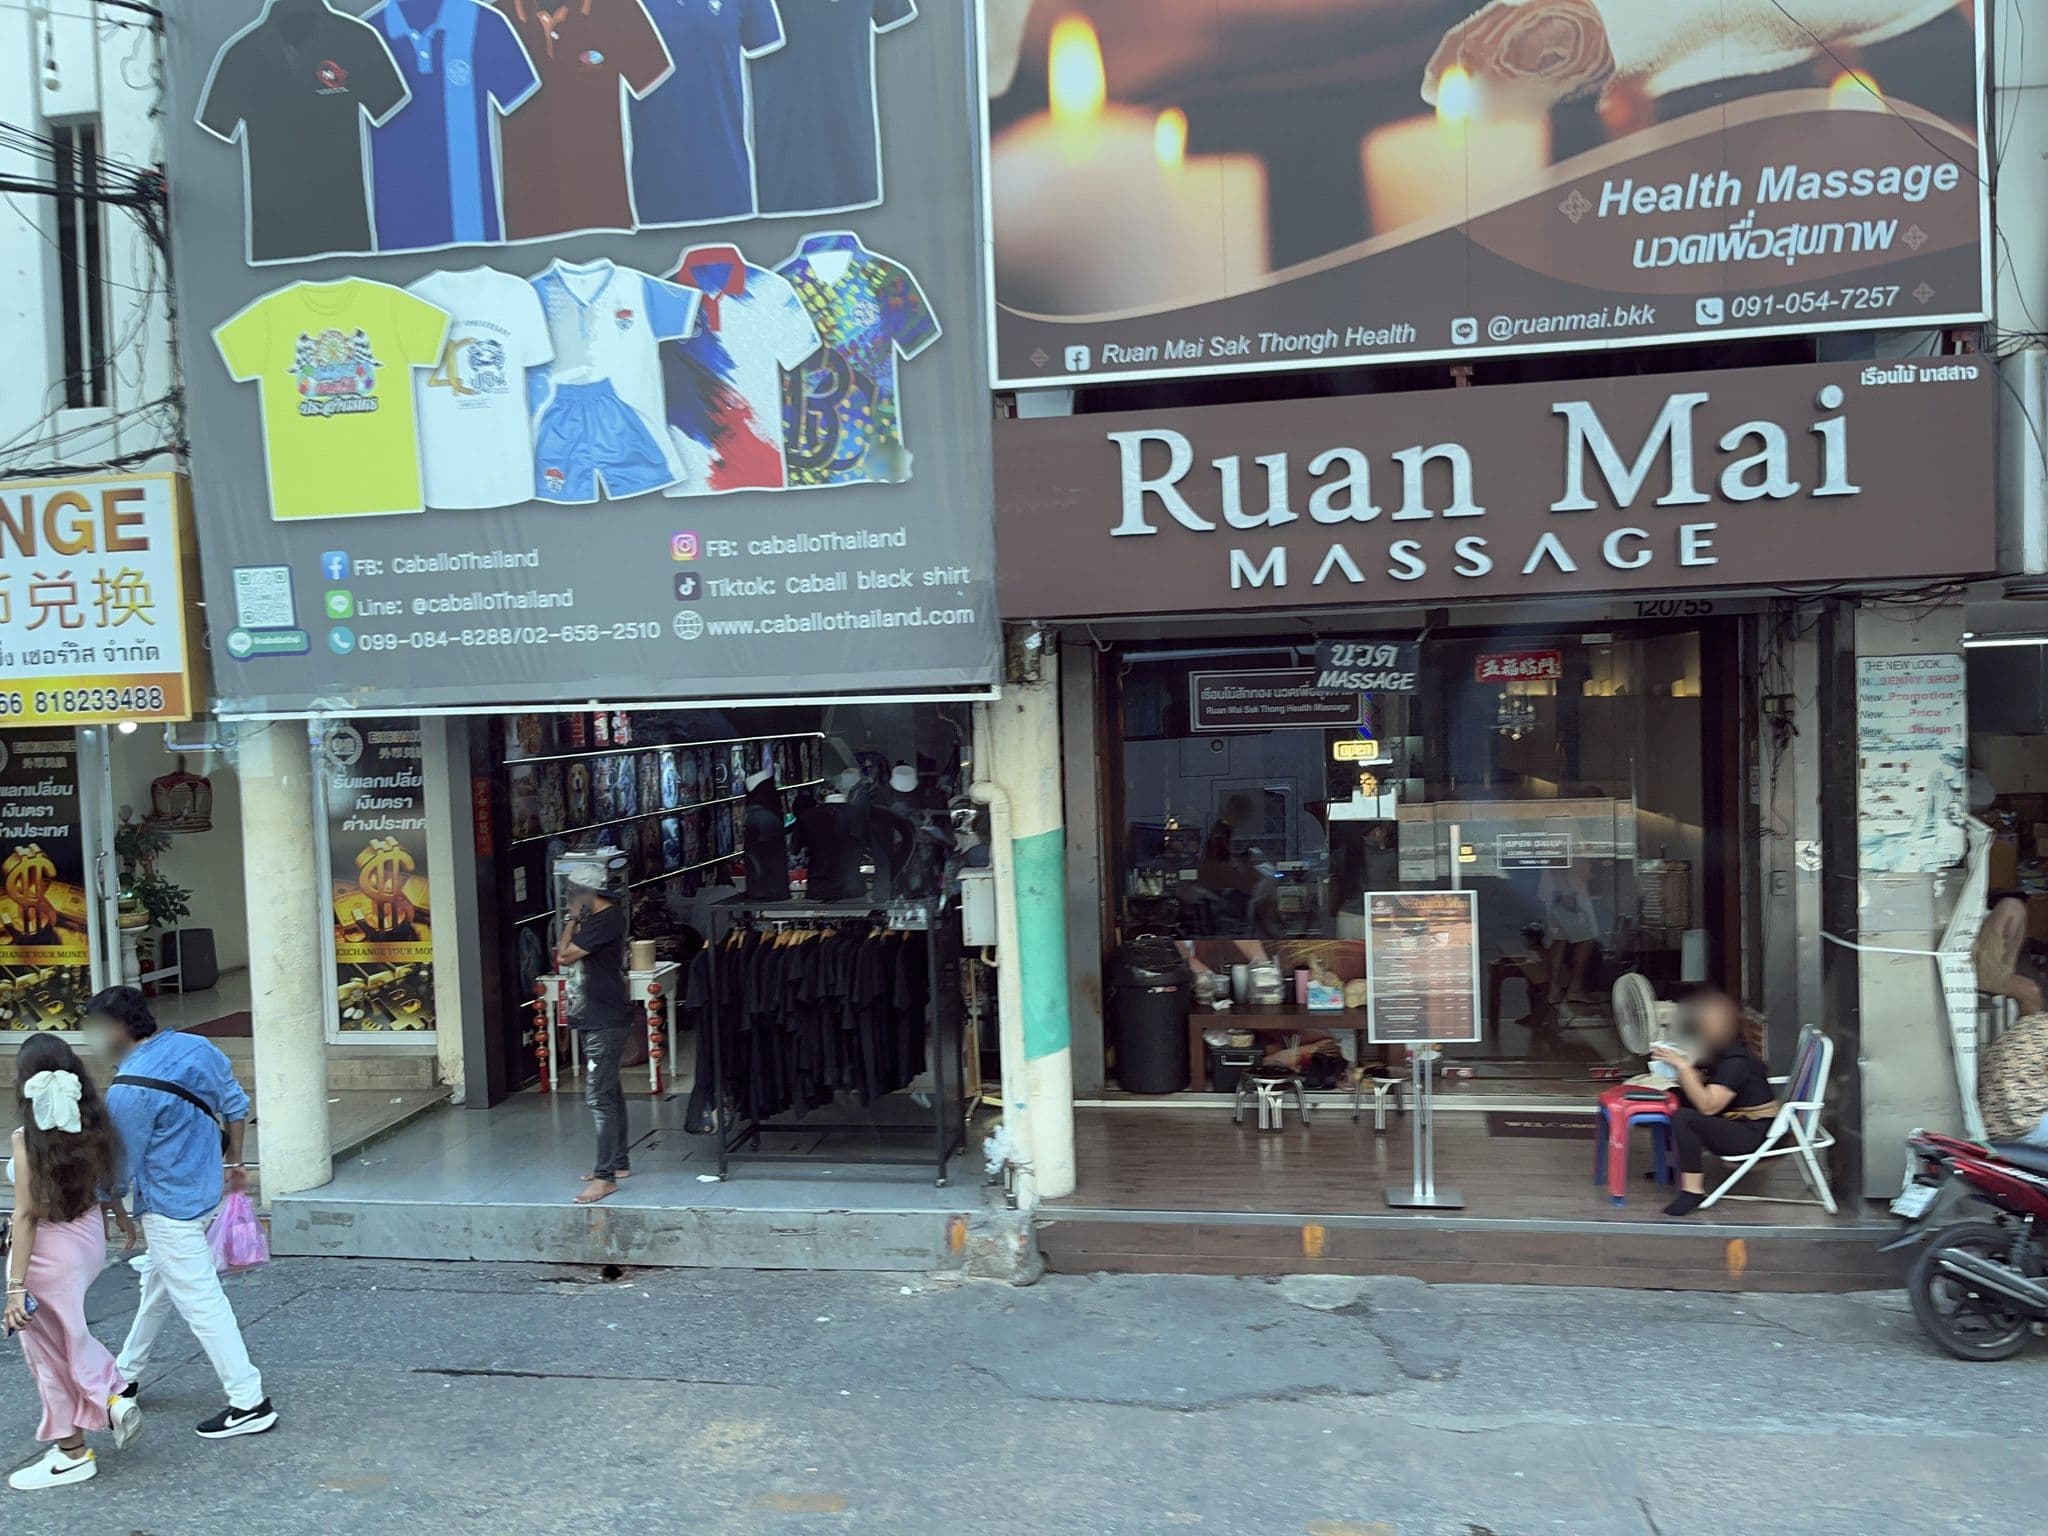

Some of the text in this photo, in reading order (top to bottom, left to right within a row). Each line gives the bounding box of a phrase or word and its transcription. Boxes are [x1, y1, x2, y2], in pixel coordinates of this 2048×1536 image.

[1597, 161, 1959, 217] Health Massage
[1633, 209, 1898, 268] นวดเพื่อสุขภาพ
[1731, 285, 1900, 318] 091-054-7257
[1487, 303, 1656, 342] @ruanmai.bkk
[1102, 322, 1417, 365] Ruan Mai Sak Thongh Health
[1107, 384, 1863, 538] Ruan Mai
[705, 540, 738, 557] FB:
[1229, 521, 1719, 590] MASSAGE
[353, 559, 383, 577] FB:
[706, 566, 970, 597] Tiktok: Caball black shirt
[357, 597, 402, 617] Line:
[1633, 600, 1713, 616] 120/55
[707, 606, 975, 636] www.caballothailand.com
[103, 638, 160, 663] จำกัด
[1863, 661, 1884, 672] THE
[1886, 660, 1909, 671] NEW
[1317, 670, 1416, 690] MASSAGE
[35, 686, 163, 712] 818233488
[1889, 692, 1953, 701] Promotion
[1206, 706, 1227, 715] Ruan
[1244, 705, 1259, 714] Sak
[1260, 705, 1286, 715] Thong
[1286, 703, 1312, 713] Health
[1313, 703, 1351, 714] Massage
[2, 803, 54, 817] เงินตรา
[355, 795, 413, 809] เงินตรา
[387, 948, 412, 956] YOUR
